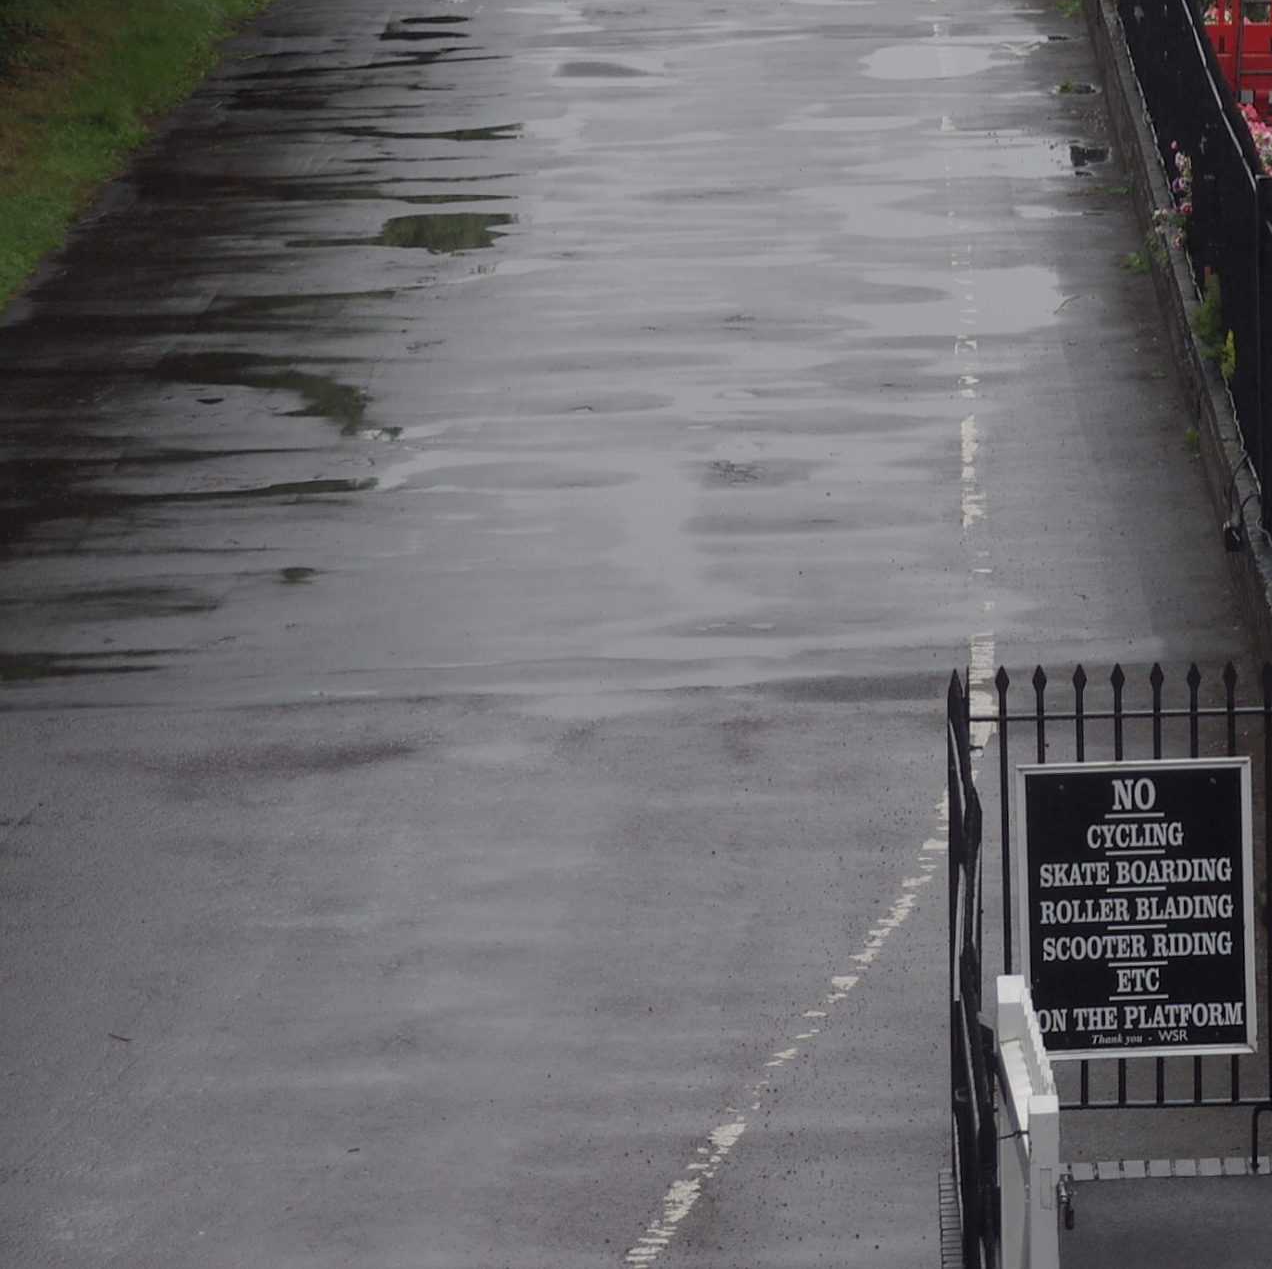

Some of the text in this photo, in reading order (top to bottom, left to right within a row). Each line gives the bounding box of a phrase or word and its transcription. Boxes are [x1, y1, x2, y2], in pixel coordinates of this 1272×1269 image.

[1111, 777, 1157, 811] NO
[1086, 821, 1185, 849] CYCLING
[1039, 857, 1233, 888] SKATE BOARDING
[1039, 895, 1234, 925] ROLLER BLADING
[1042, 931, 1233, 962] SCOOTER RIDING
[1116, 967, 1161, 993] ETC
[1036, 1002, 1244, 1033] ON THE PLATFORM
[1091, 1034, 1123, 1045] Thank
[1123, 1035, 1144, 1046] you
[1158, 1030, 1189, 1043] WSR
